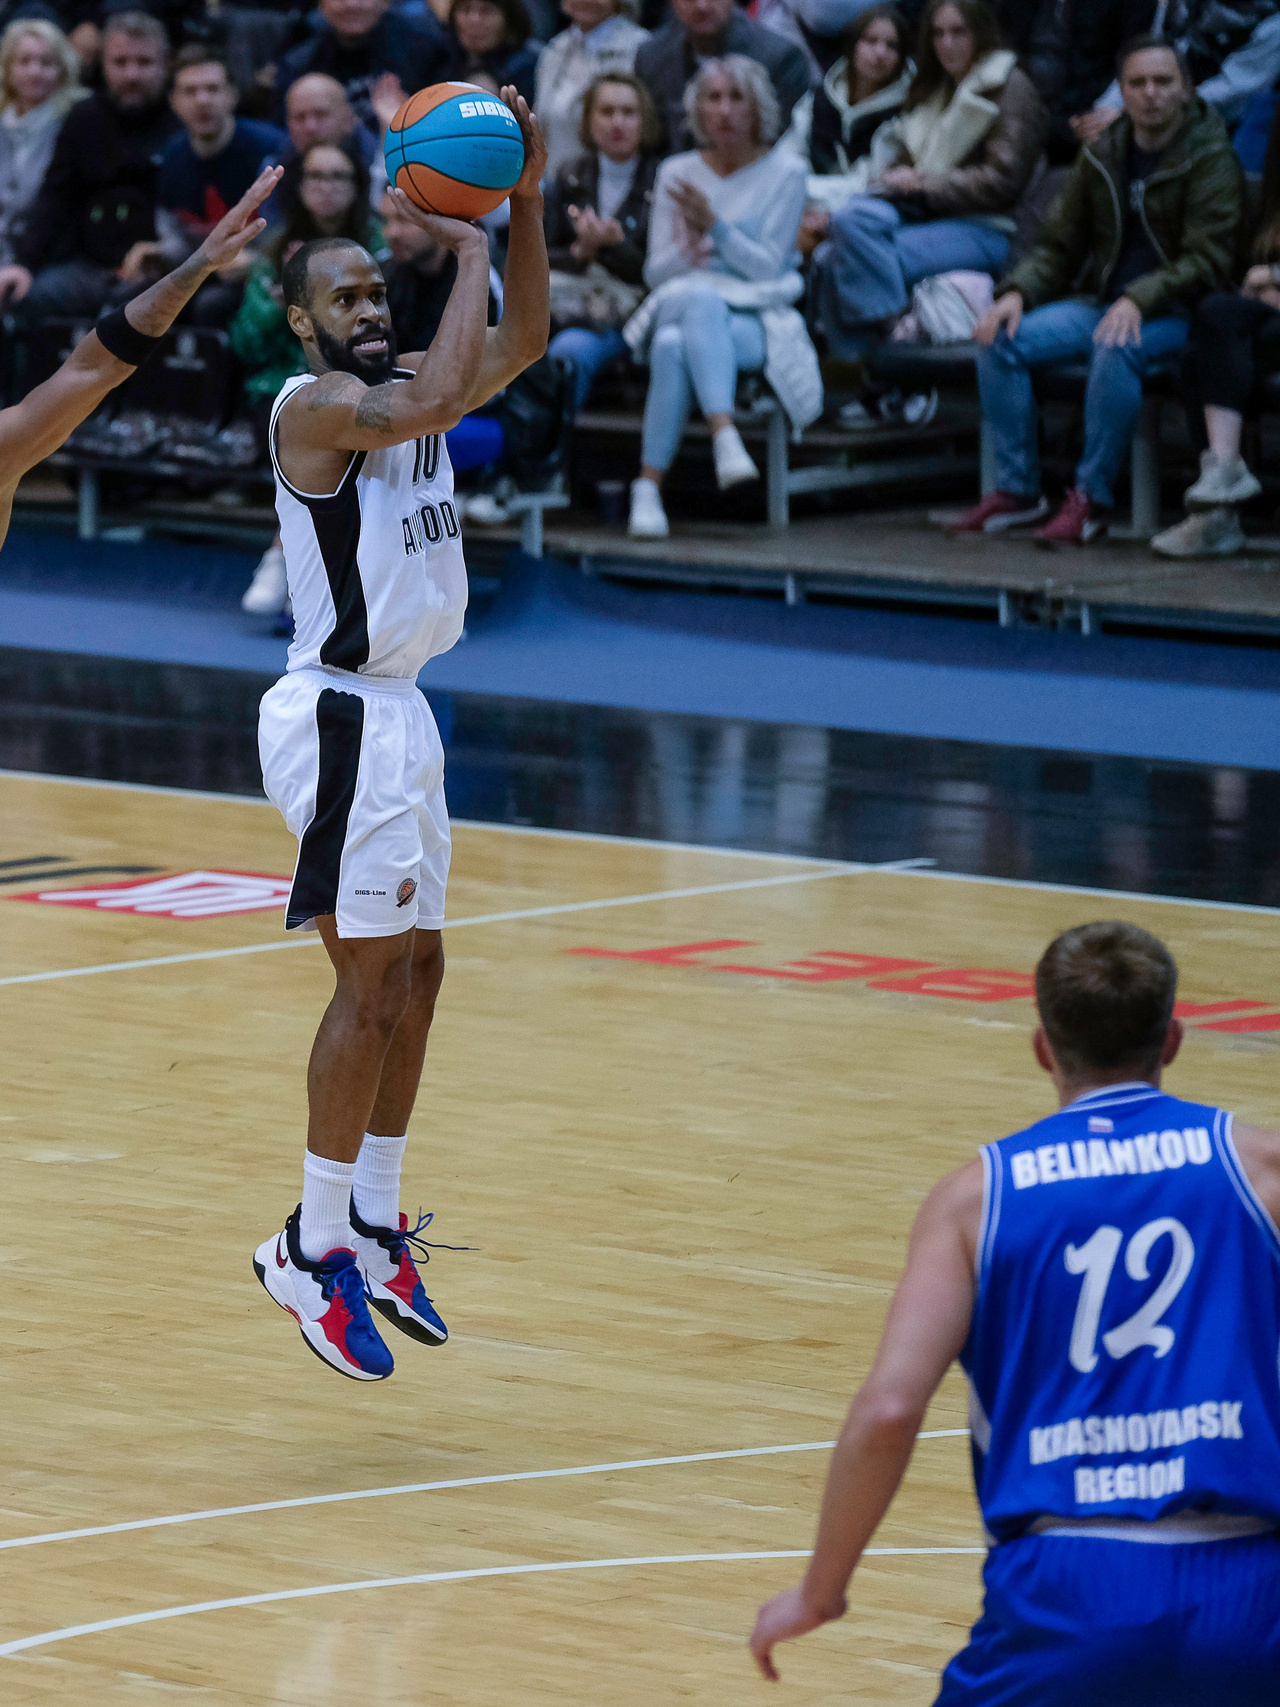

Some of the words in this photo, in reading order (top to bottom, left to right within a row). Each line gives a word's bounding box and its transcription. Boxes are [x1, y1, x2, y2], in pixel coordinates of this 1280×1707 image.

[1010, 1127, 1213, 1190] BELIANKOU
[1063, 1216, 1195, 1374] 12
[1073, 1455, 1186, 1504] REGION
